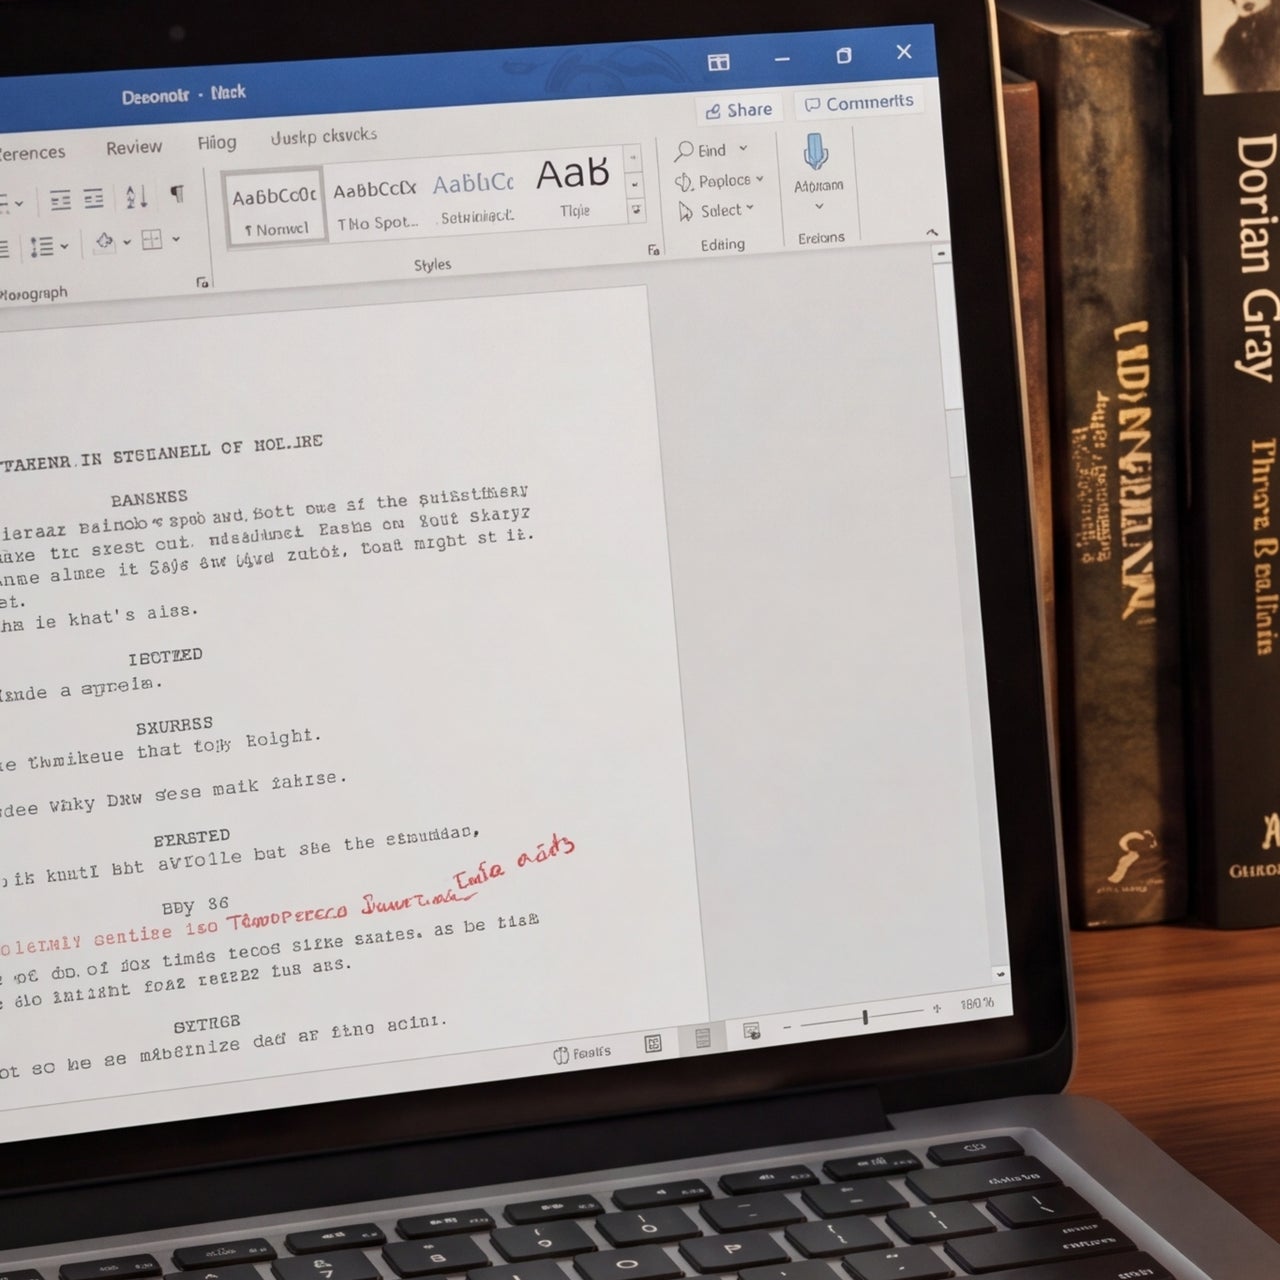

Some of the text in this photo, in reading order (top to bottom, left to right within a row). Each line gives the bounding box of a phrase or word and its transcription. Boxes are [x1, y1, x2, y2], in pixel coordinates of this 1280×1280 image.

[728, 103, 773, 117] Share
[107, 140, 162, 156] Review
[414, 258, 452, 273] Styles
[1234, 134, 1280, 383] Dorian Gray
[377, 495, 408, 509] the
[137, 742, 182, 759] that
[345, 837, 375, 851] the
[464, 918, 486, 934] be
[724, 1243, 742, 1256] P
